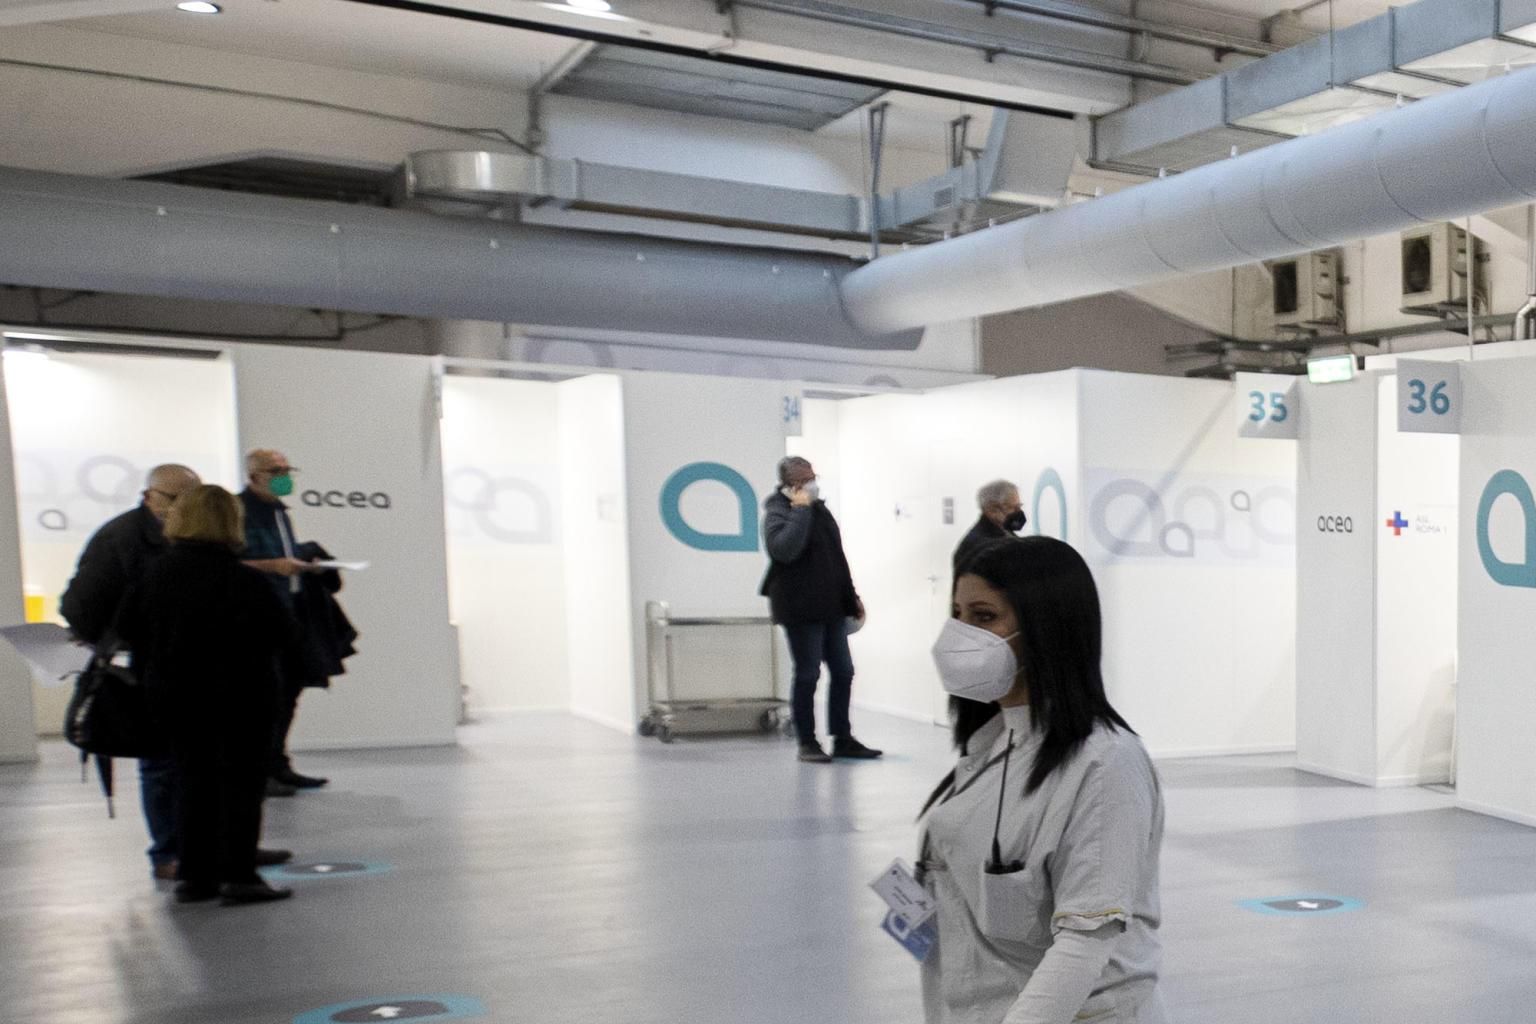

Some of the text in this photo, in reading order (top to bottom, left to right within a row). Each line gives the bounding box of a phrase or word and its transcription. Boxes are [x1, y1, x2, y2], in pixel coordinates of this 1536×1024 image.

[1247, 389, 1288, 424] 35
[1406, 378, 1451, 416] 36
[300, 489, 392, 509] acea
[1316, 513, 1353, 534] acea
